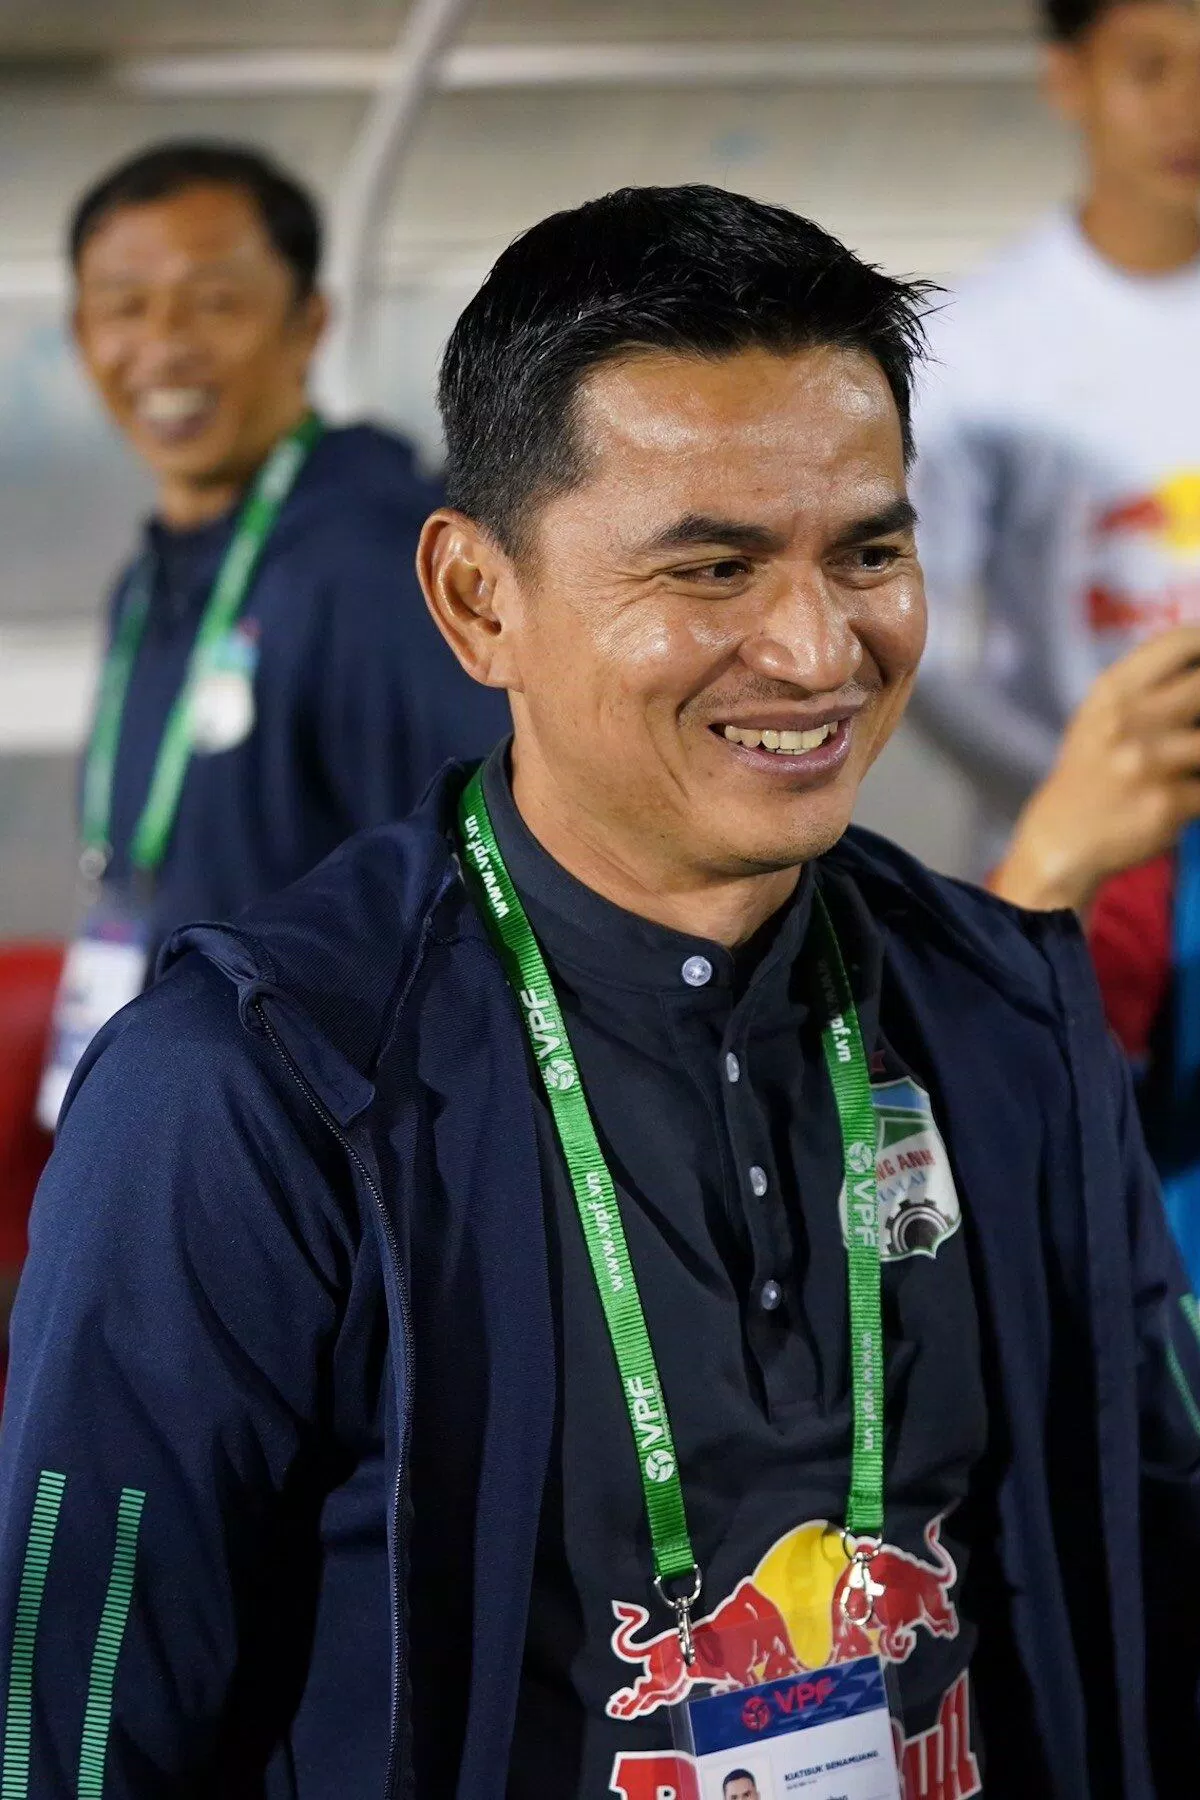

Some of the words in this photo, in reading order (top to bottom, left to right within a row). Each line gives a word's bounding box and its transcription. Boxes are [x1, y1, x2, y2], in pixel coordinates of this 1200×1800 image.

[465, 814, 510, 919] www.vpf.vn
[520, 988, 562, 1060] VPF
[586, 1171, 624, 1292] www.vpf.vn
[853, 1179, 876, 1247] VPF
[627, 1375, 664, 1450] VPF
[773, 1677, 835, 1714] VPF
